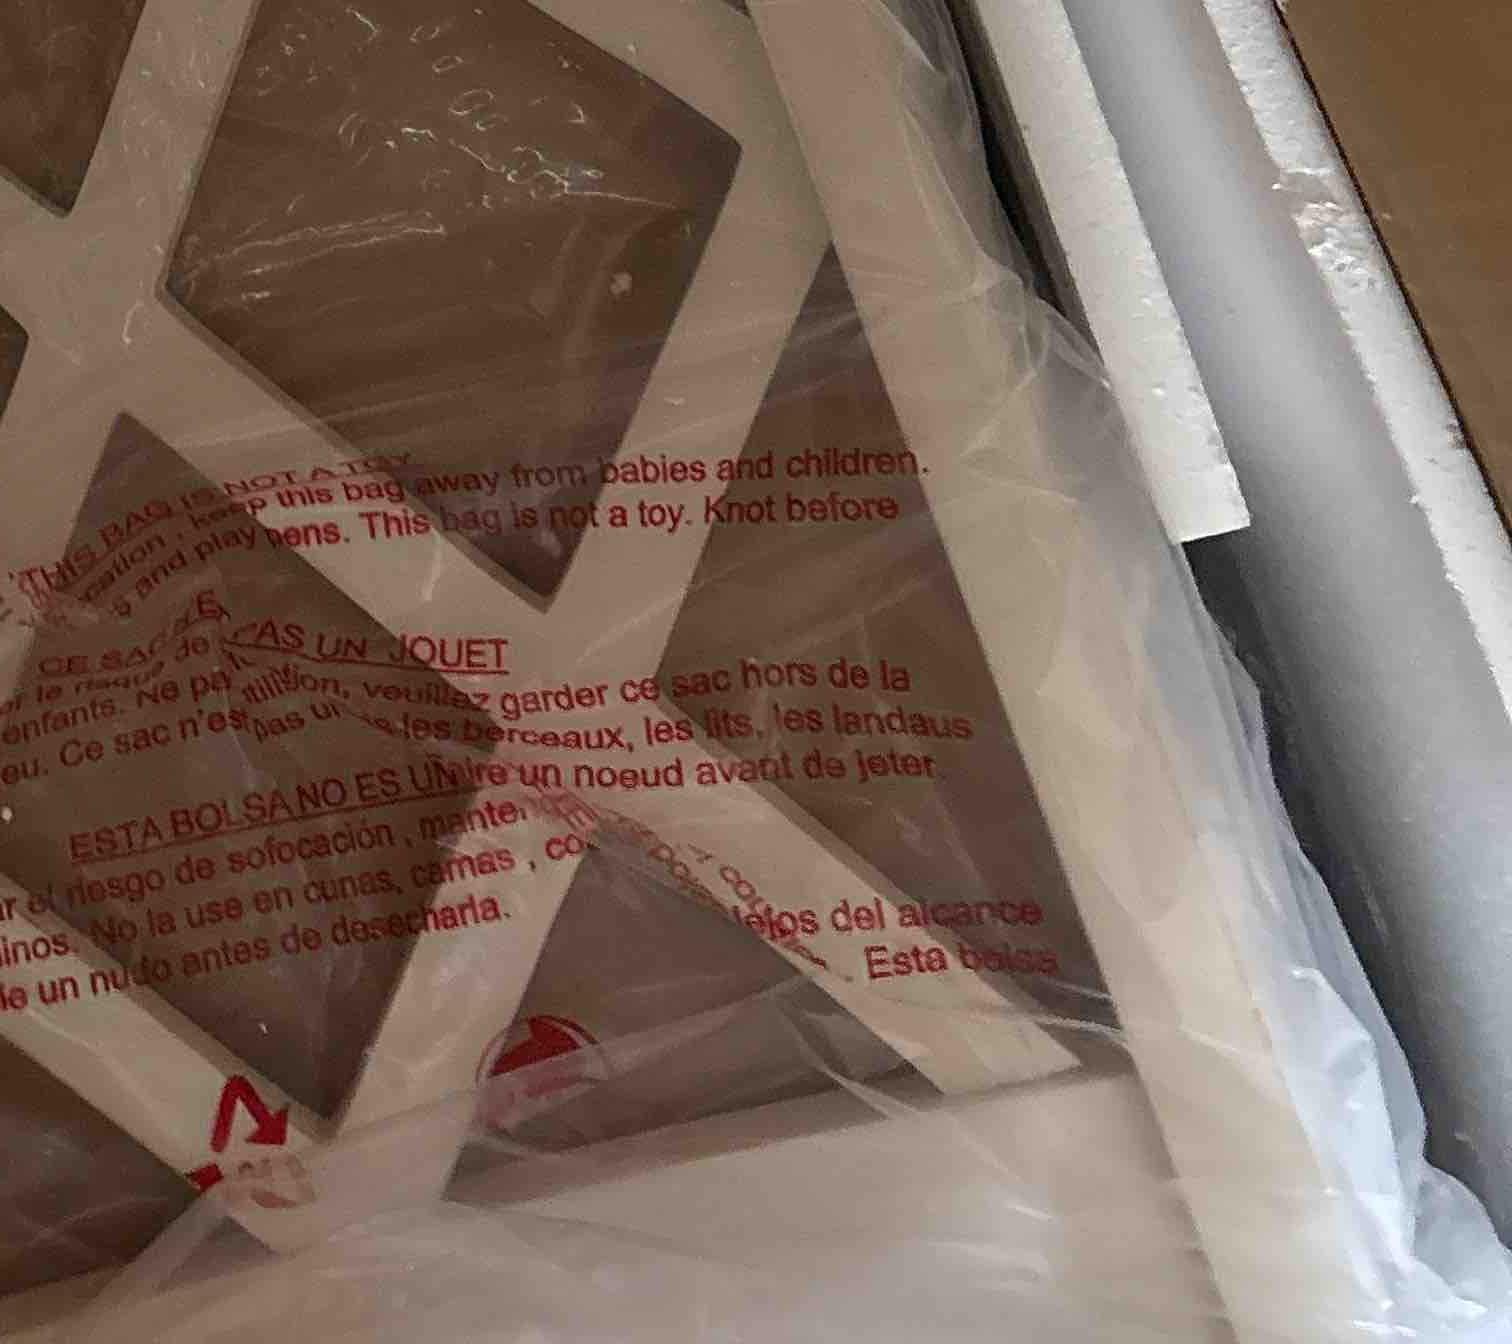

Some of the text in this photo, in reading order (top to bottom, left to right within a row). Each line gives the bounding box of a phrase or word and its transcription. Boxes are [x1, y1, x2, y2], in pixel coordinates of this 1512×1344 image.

[97, 500, 172, 547] BAG
[223, 470, 297, 497] NOT
[311, 464, 338, 481] A
[276, 482, 335, 507] this
[343, 478, 406, 505] bag
[416, 468, 500, 496] away
[511, 463, 587, 489] from
[601, 454, 707, 485] babies
[716, 448, 776, 481] and
[784, 446, 930, 479] children.
[193, 526, 257, 561] play
[358, 507, 431, 541] This
[440, 500, 503, 534] bag
[512, 500, 538, 529] is
[548, 498, 601, 528] not
[608, 504, 629, 528] a
[638, 500, 691, 535] toy.
[702, 495, 778, 526] Knot
[788, 491, 901, 524] before
[317, 632, 369, 659] UN
[389, 634, 509, 669] JOUET
[137, 679, 180, 710] Ne
[501, 682, 608, 720] garder
[621, 677, 661, 704] ce
[672, 670, 731, 700] sac
[741, 658, 817, 690] hors
[827, 658, 869, 689] de
[879, 658, 912, 692] la
[58, 736, 106, 770] Ce
[112, 726, 172, 757] sac
[252, 713, 306, 744] pas
[463, 718, 635, 753] berceaux,
[644, 716, 693, 746] les
[775, 704, 824, 736] les
[832, 703, 975, 743] landaus
[575, 758, 684, 788] noeud
[696, 756, 793, 785] avant
[803, 748, 845, 779] de
[854, 749, 935, 782] jeter
[69, 816, 164, 860] ESTA
[170, 789, 291, 840] BOLSA
[296, 779, 348, 812] NO
[358, 766, 401, 801] ES
[28, 886, 56, 914] el
[69, 868, 165, 908] riesgo
[174, 854, 216, 884] de
[227, 818, 395, 872] sofocación
[88, 915, 138, 947] No
[146, 904, 177, 935] la
[187, 897, 244, 929] use
[253, 885, 295, 913] en
[409, 846, 516, 888] camas
[831, 898, 884, 933] del
[898, 898, 1044, 929] alcance
[37, 974, 79, 1008] un
[88, 952, 173, 992] nudo
[182, 934, 274, 977] antes
[280, 919, 323, 954] de
[864, 943, 947, 980] Esta
[958, 939, 1059, 976] bolsa
